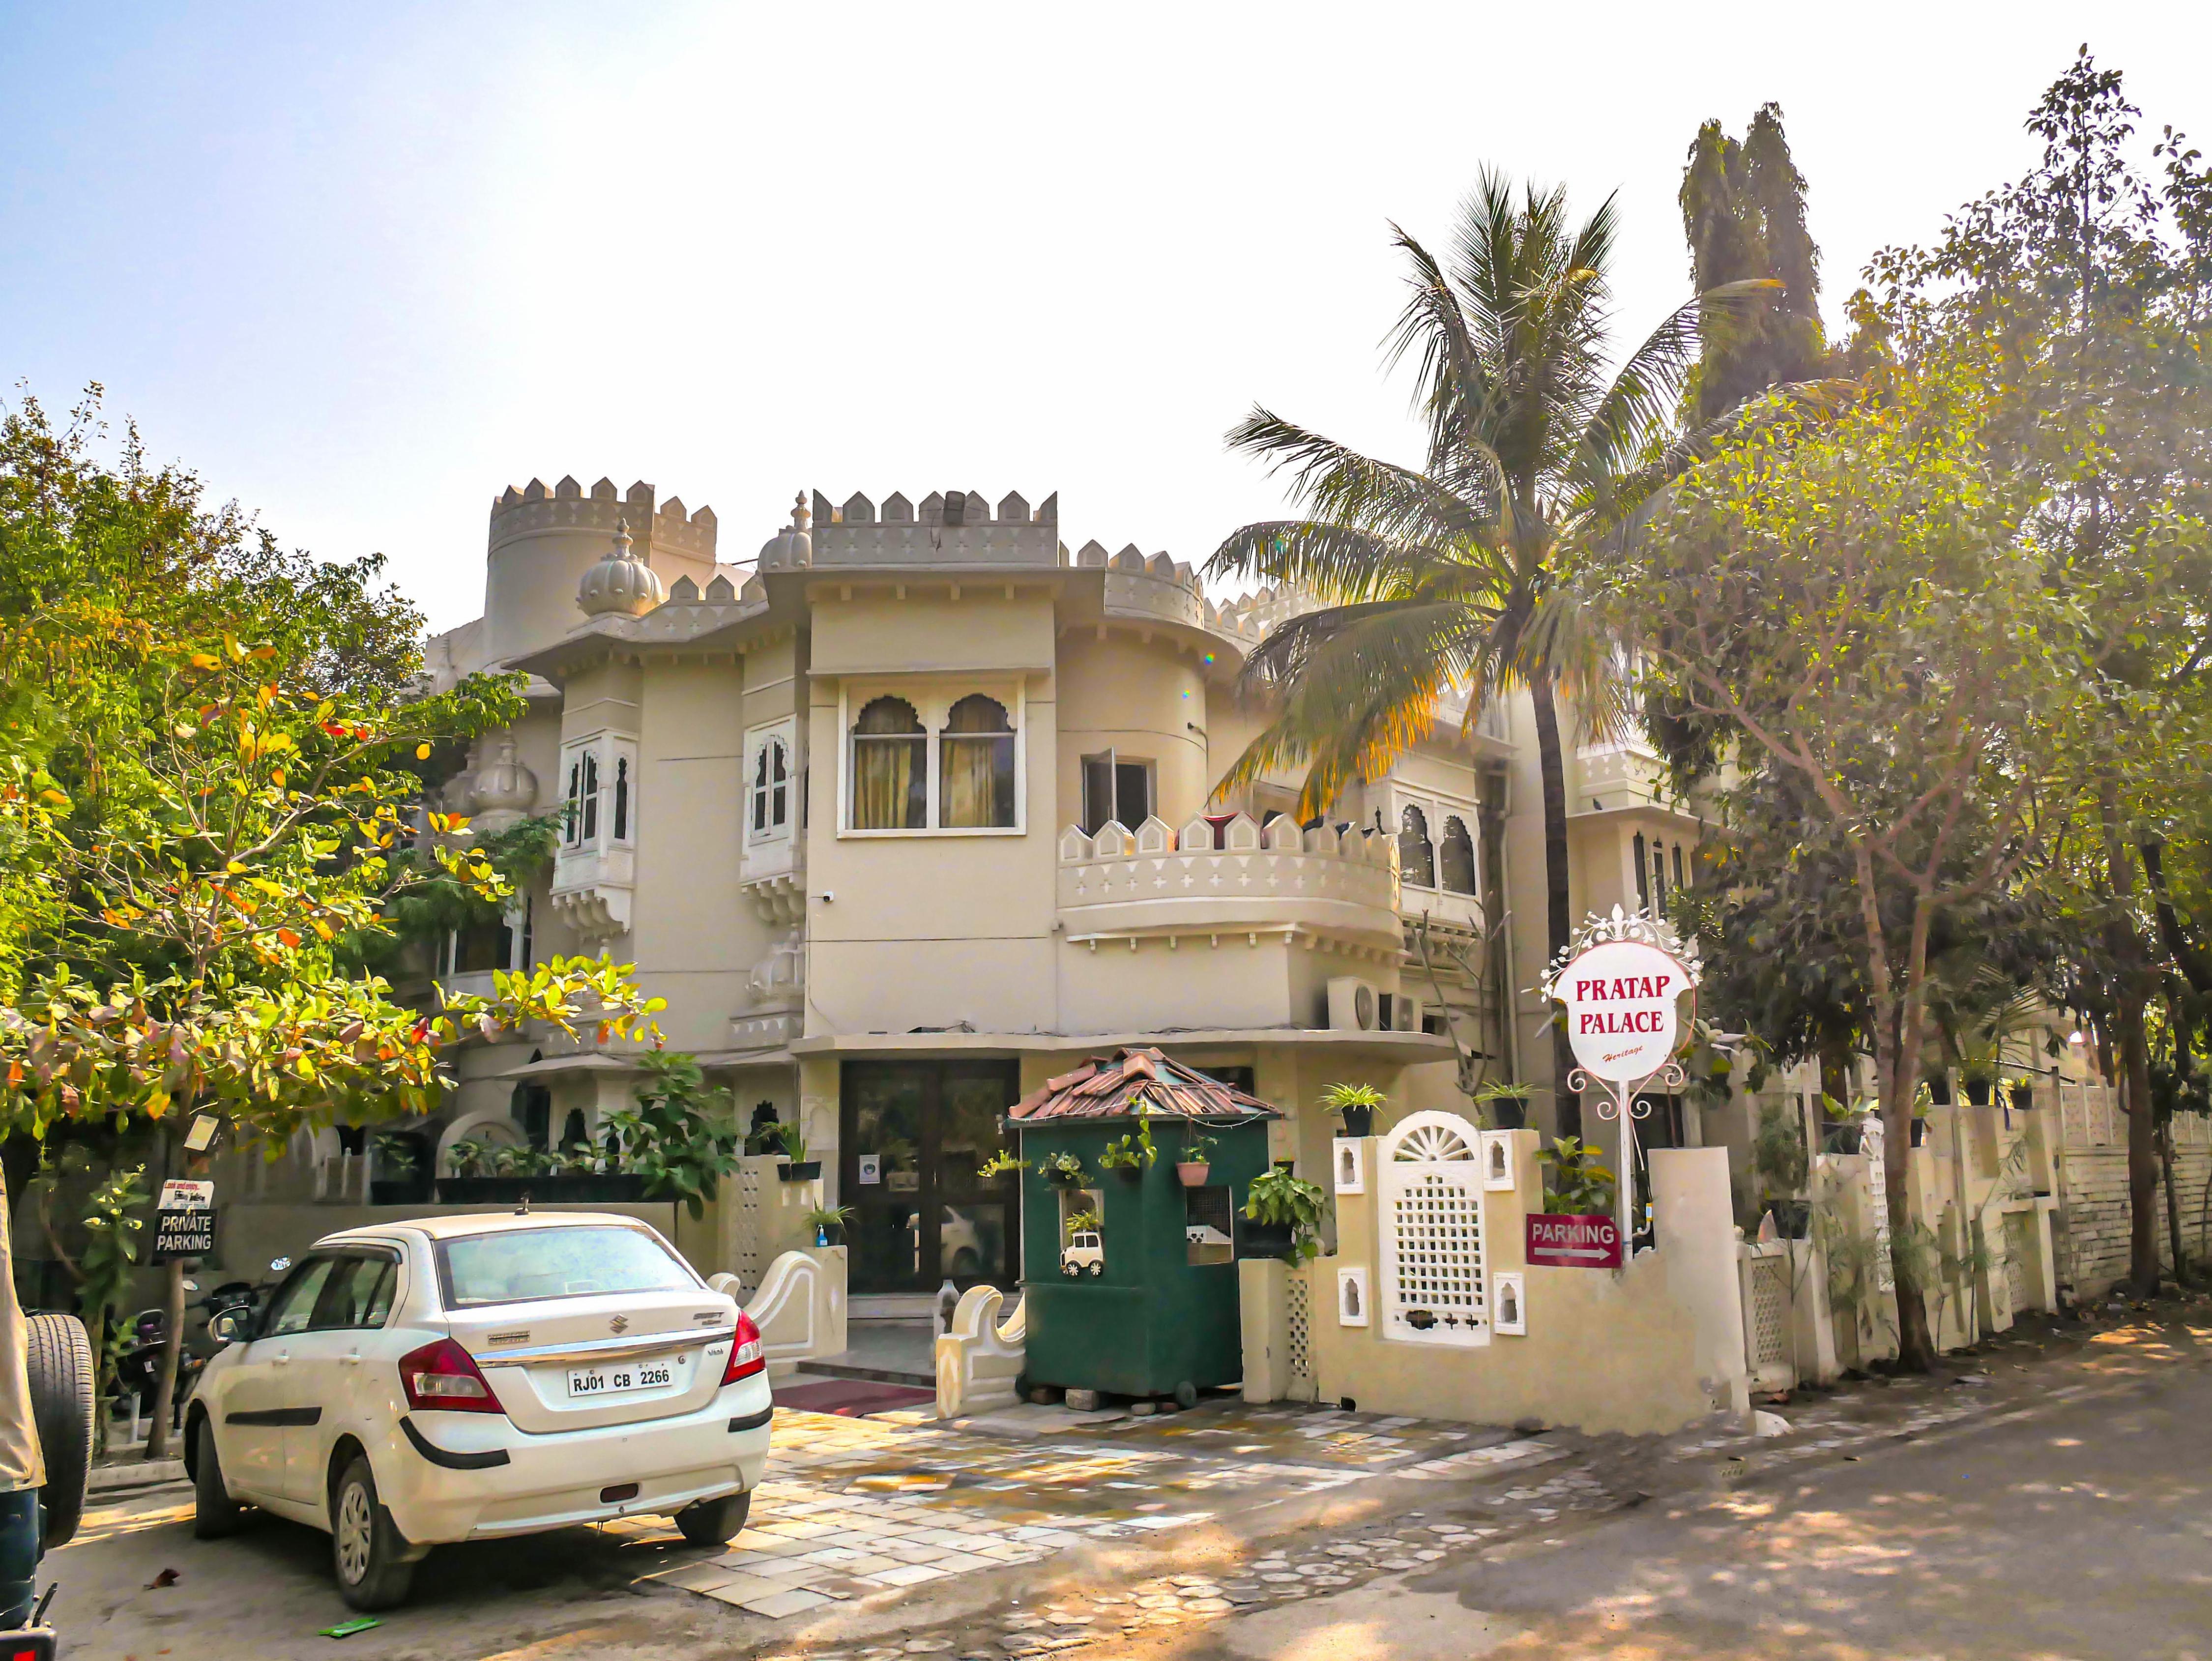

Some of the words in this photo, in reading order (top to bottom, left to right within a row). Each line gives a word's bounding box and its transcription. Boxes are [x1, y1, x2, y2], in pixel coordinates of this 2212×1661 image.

[1576, 976, 1670, 1001] PRATAP
[1580, 1011, 1664, 1034] PALACE
[1602, 1045, 1643, 1063] Heritage
[162, 1216, 211, 1231] PRIVATE
[1532, 1223, 1614, 1244] PARKING
[157, 1234, 211, 1251] PARKING
[574, 1375, 604, 1392] RJ01
[614, 1374, 631, 1387] CB
[640, 1370, 669, 1385] 2266
